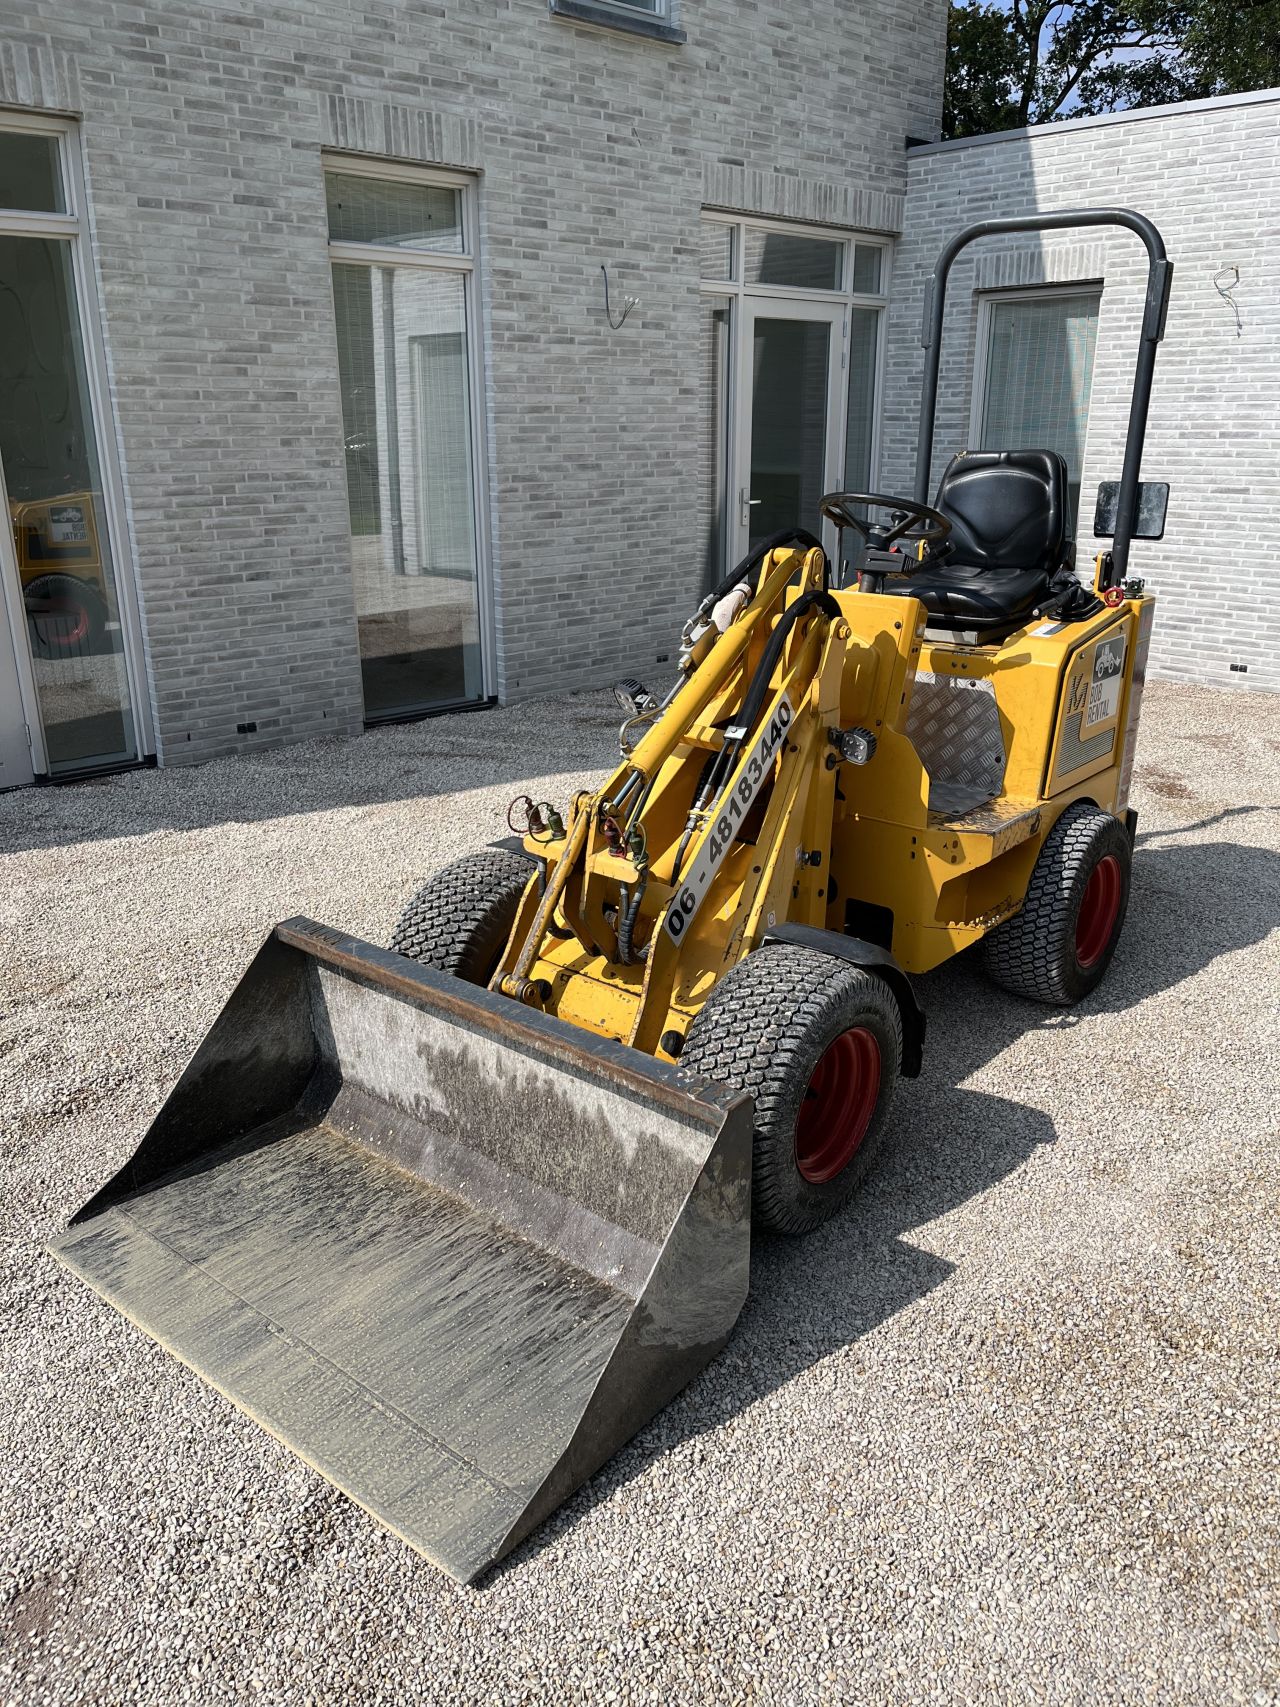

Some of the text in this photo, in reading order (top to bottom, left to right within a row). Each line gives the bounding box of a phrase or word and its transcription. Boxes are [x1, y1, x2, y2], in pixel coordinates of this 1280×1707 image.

[1089, 682, 1103, 705] BOB
[1087, 699, 1110, 725] RENTAL
[667, 886, 696, 937] 06
[708, 701, 792, 865] 48183440
